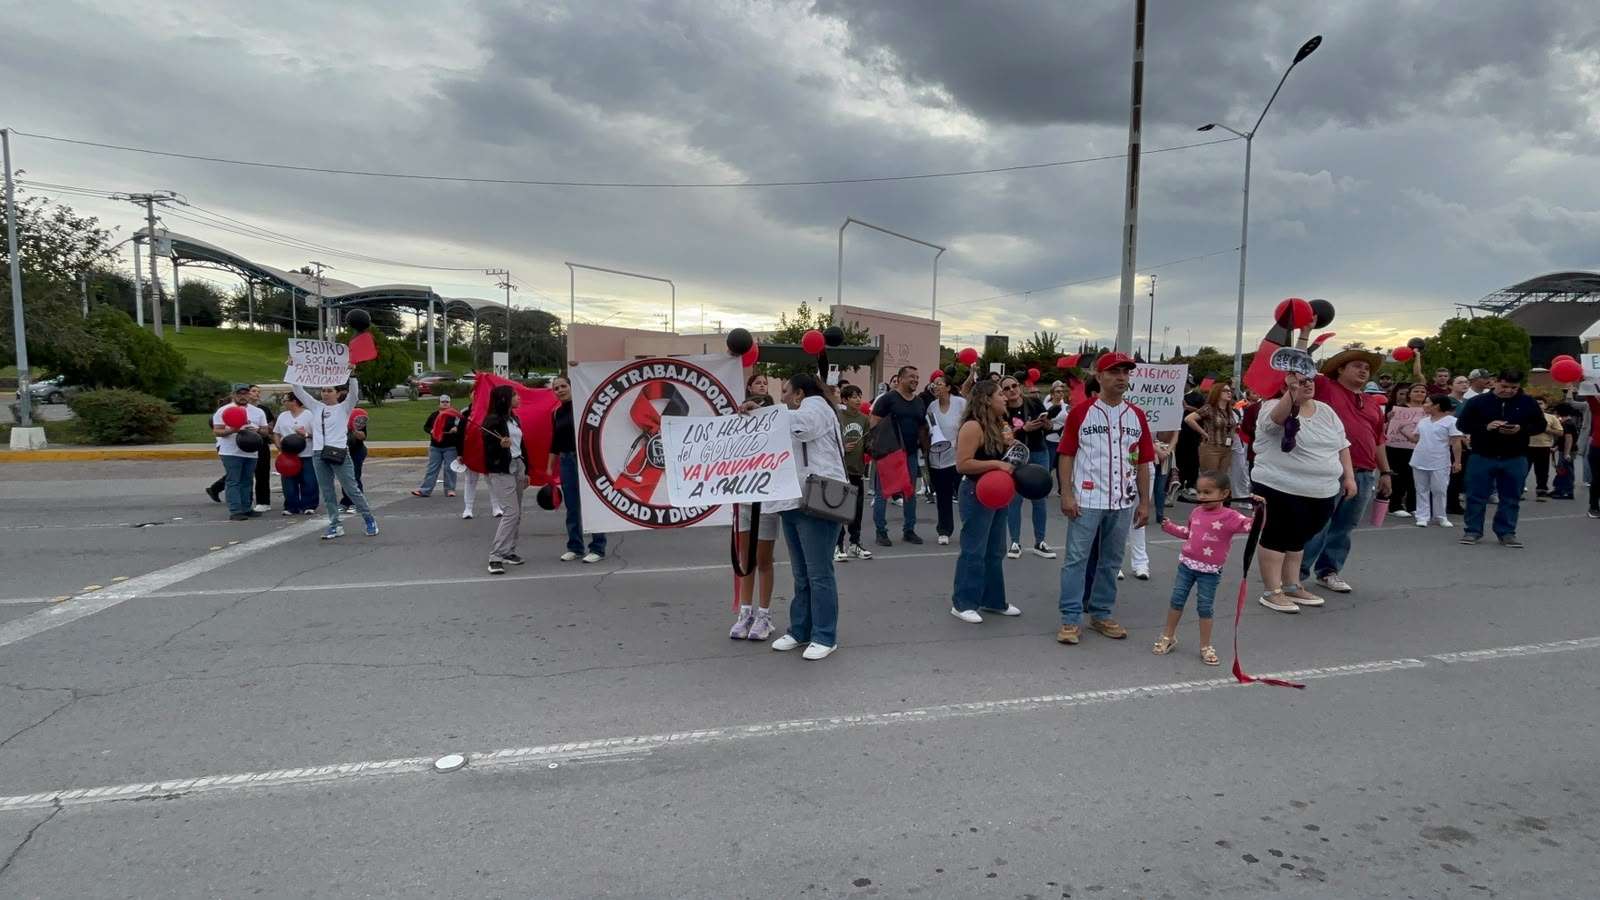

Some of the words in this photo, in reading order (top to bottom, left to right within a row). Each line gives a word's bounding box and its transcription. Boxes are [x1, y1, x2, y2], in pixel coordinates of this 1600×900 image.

[296, 340, 344, 355] SEGURO
[305, 355, 338, 365] SOCIAL
[587, 384, 620, 427] BASE
[617, 364, 734, 416] TRABAJADORA
[1140, 383, 1176, 394] NUEVO
[682, 421, 714, 445] LOS
[716, 409, 779, 438] HEROES
[1146, 409, 1160, 422] SS
[1082, 424, 1110, 435] SEÑOR
[700, 432, 769, 463] COVID
[682, 463, 703, 481] YA
[704, 450, 790, 481] VOLVIMOS
[688, 481, 704, 498] A
[710, 471, 771, 495] SALIR
[595, 475, 652, 520] UNIDAD
[655, 509, 666, 524] Y
[669, 505, 710, 523] DIGN
